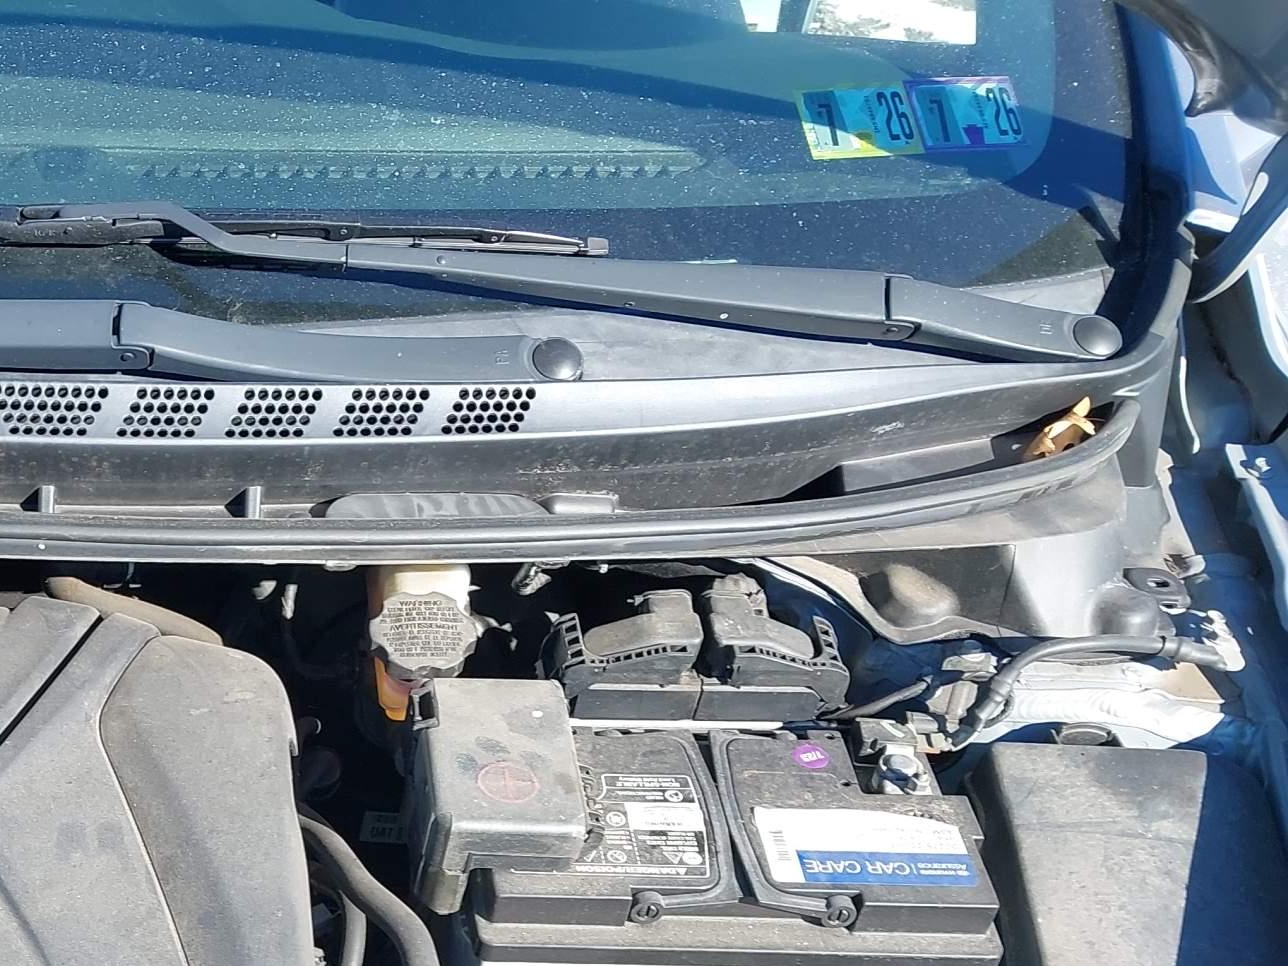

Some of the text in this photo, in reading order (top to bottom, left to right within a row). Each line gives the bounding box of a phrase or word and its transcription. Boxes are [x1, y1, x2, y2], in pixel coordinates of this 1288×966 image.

[817, 103, 839, 147] 7
[876, 91, 915, 142] 26
[929, 99, 952, 143] 7
[985, 86, 1023, 137] 26
[803, 858, 911, 875] CAR CARE
